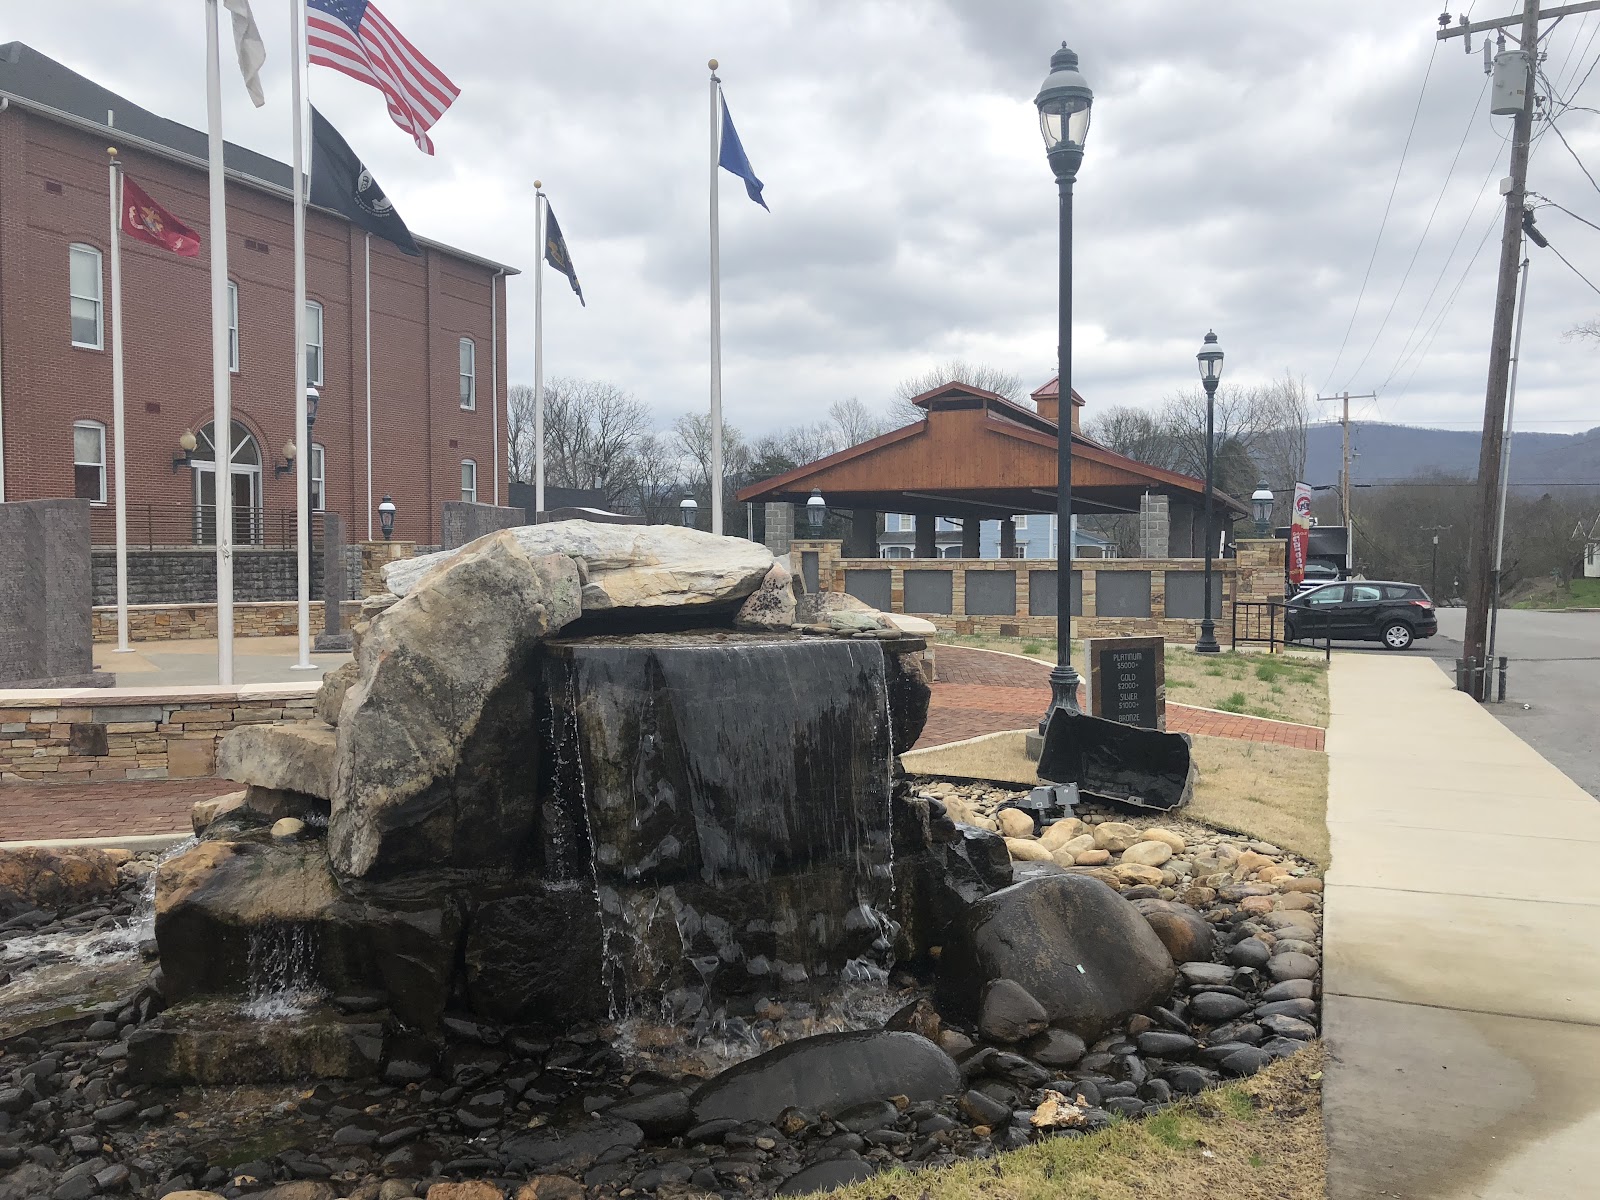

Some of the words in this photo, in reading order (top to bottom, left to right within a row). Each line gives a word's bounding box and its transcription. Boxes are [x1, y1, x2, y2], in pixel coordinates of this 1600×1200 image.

[1113, 653, 1142, 661] PLATINUM
[1120, 693, 1138, 701] SILVER
[1118, 714, 1140, 722] BRONZE
